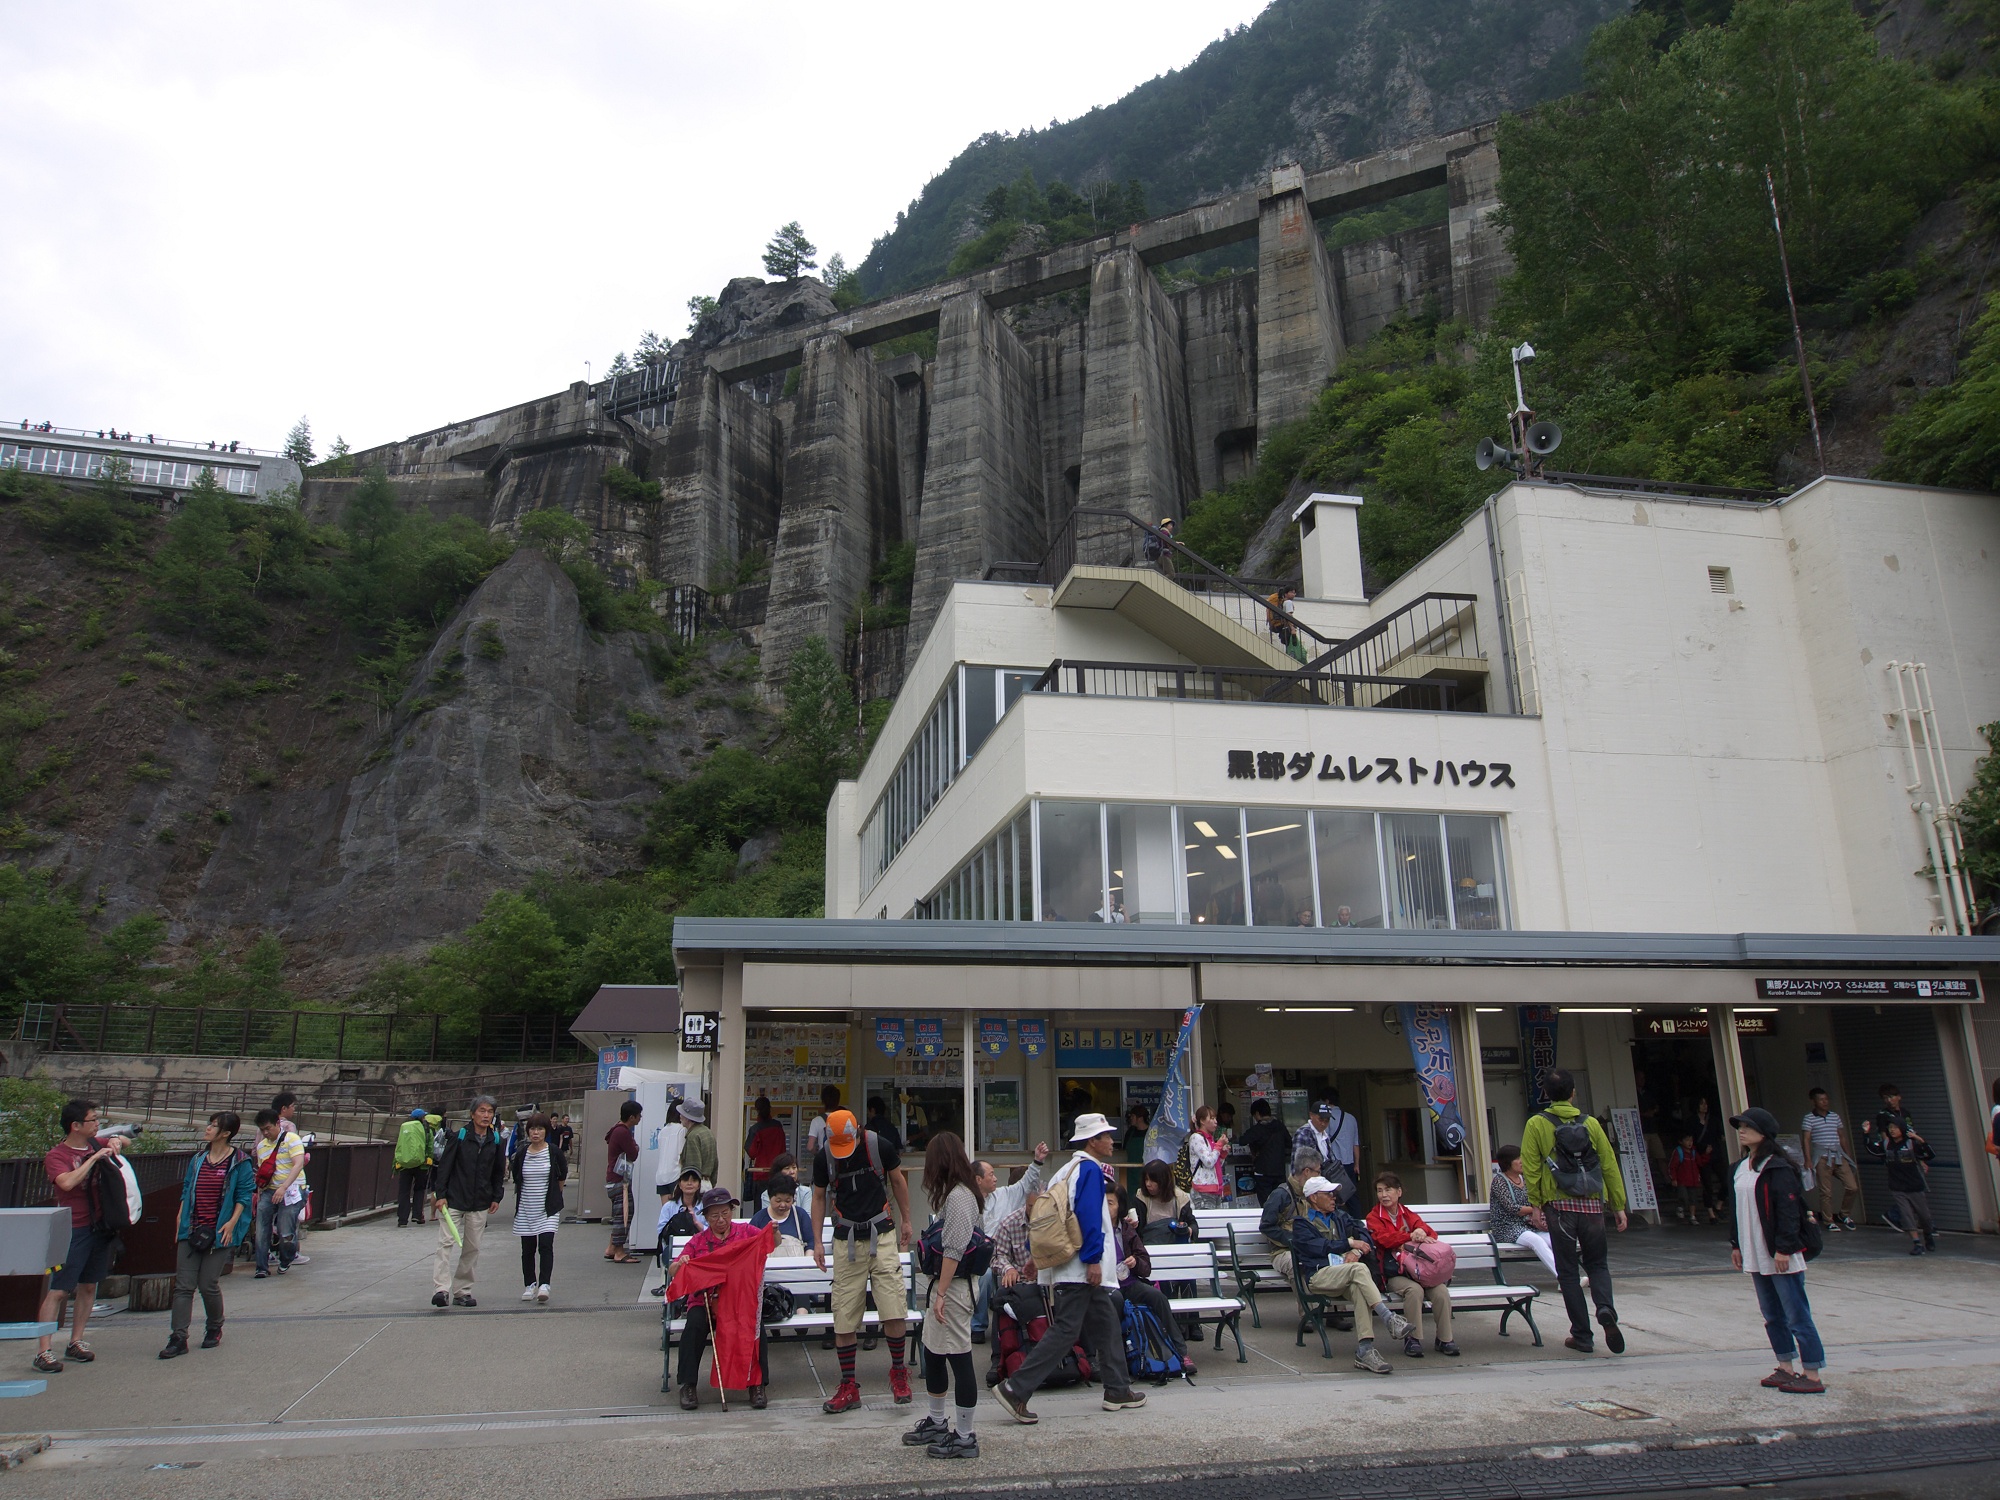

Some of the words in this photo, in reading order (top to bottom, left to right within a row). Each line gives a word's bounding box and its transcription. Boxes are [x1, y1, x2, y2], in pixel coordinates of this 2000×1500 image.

[1228, 750, 1516, 788] 黒部ダムレストハウス
[1766, 980, 1841, 989] 黒部ダムレストハウス
[1676, 1020, 1708, 1028] レストハウ
[685, 1035, 711, 1043] お手洗
[1133, 1051, 1165, 1066] 販売
